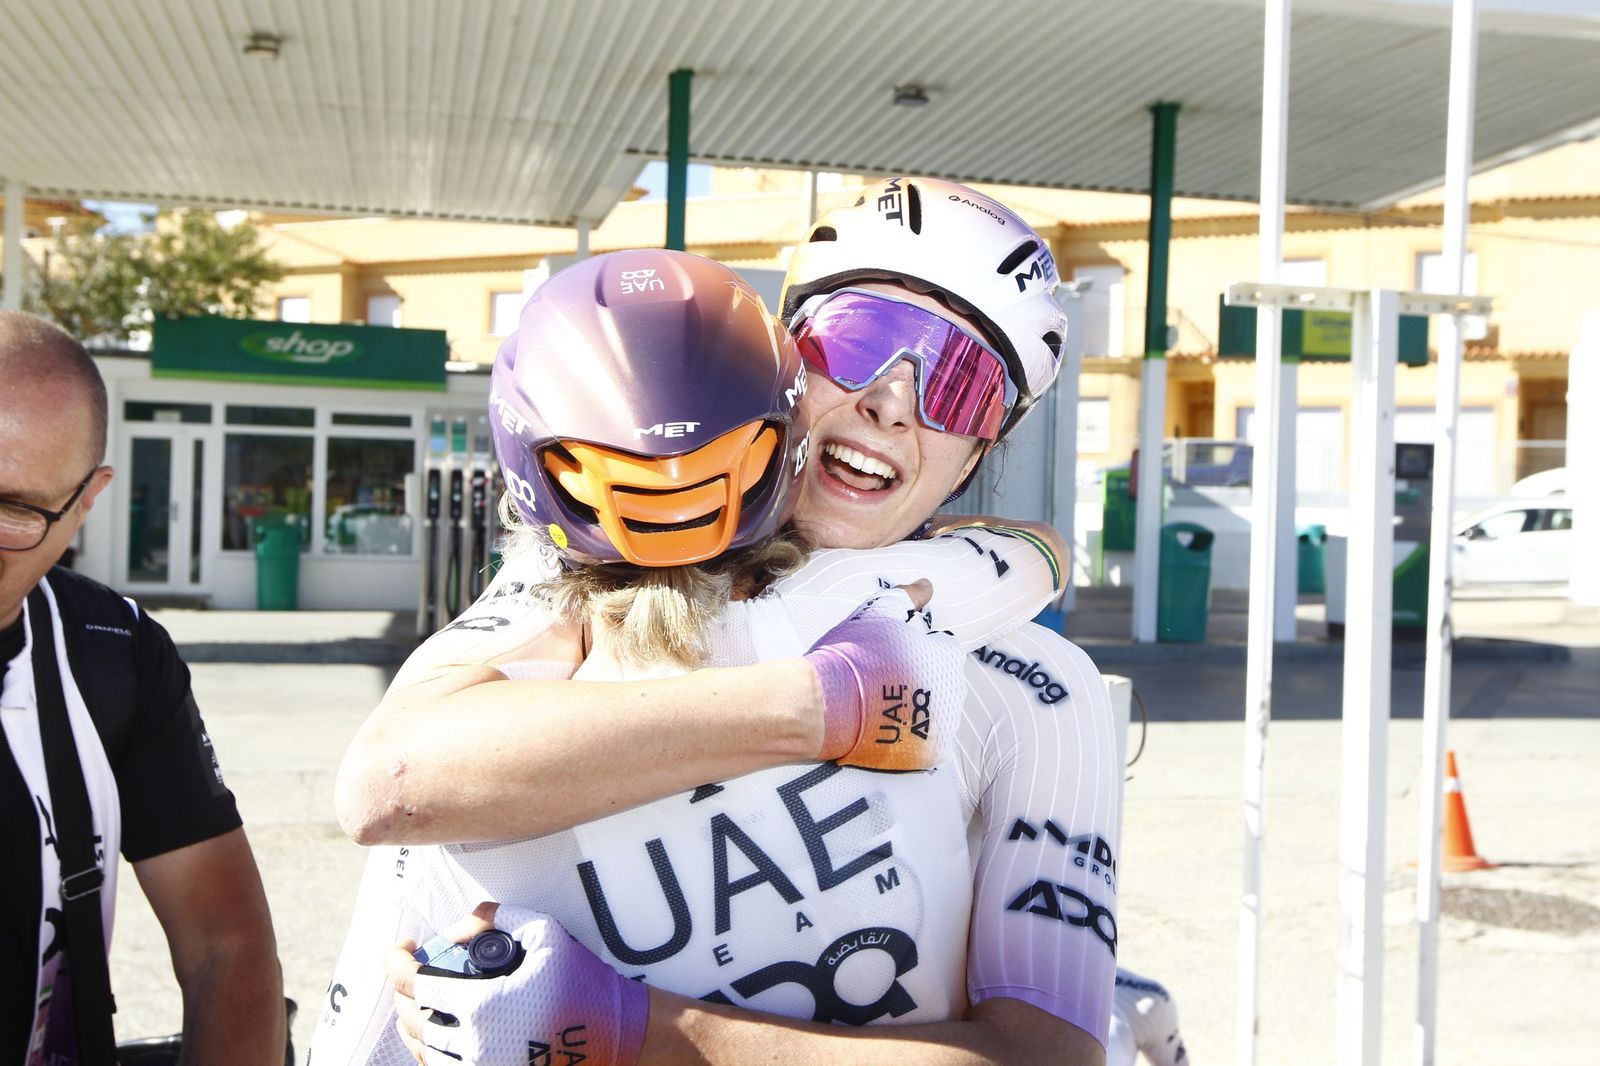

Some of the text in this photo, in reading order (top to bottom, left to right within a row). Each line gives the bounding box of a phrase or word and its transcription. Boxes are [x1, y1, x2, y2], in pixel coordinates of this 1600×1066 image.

[878, 177, 904, 227] MET
[961, 199, 1007, 226] Analog
[265, 330, 354, 363] shop
[632, 421, 701, 440] MET
[875, 685, 903, 744] UAE
[911, 688, 931, 740] ADQ
[576, 760, 893, 966] UAE
